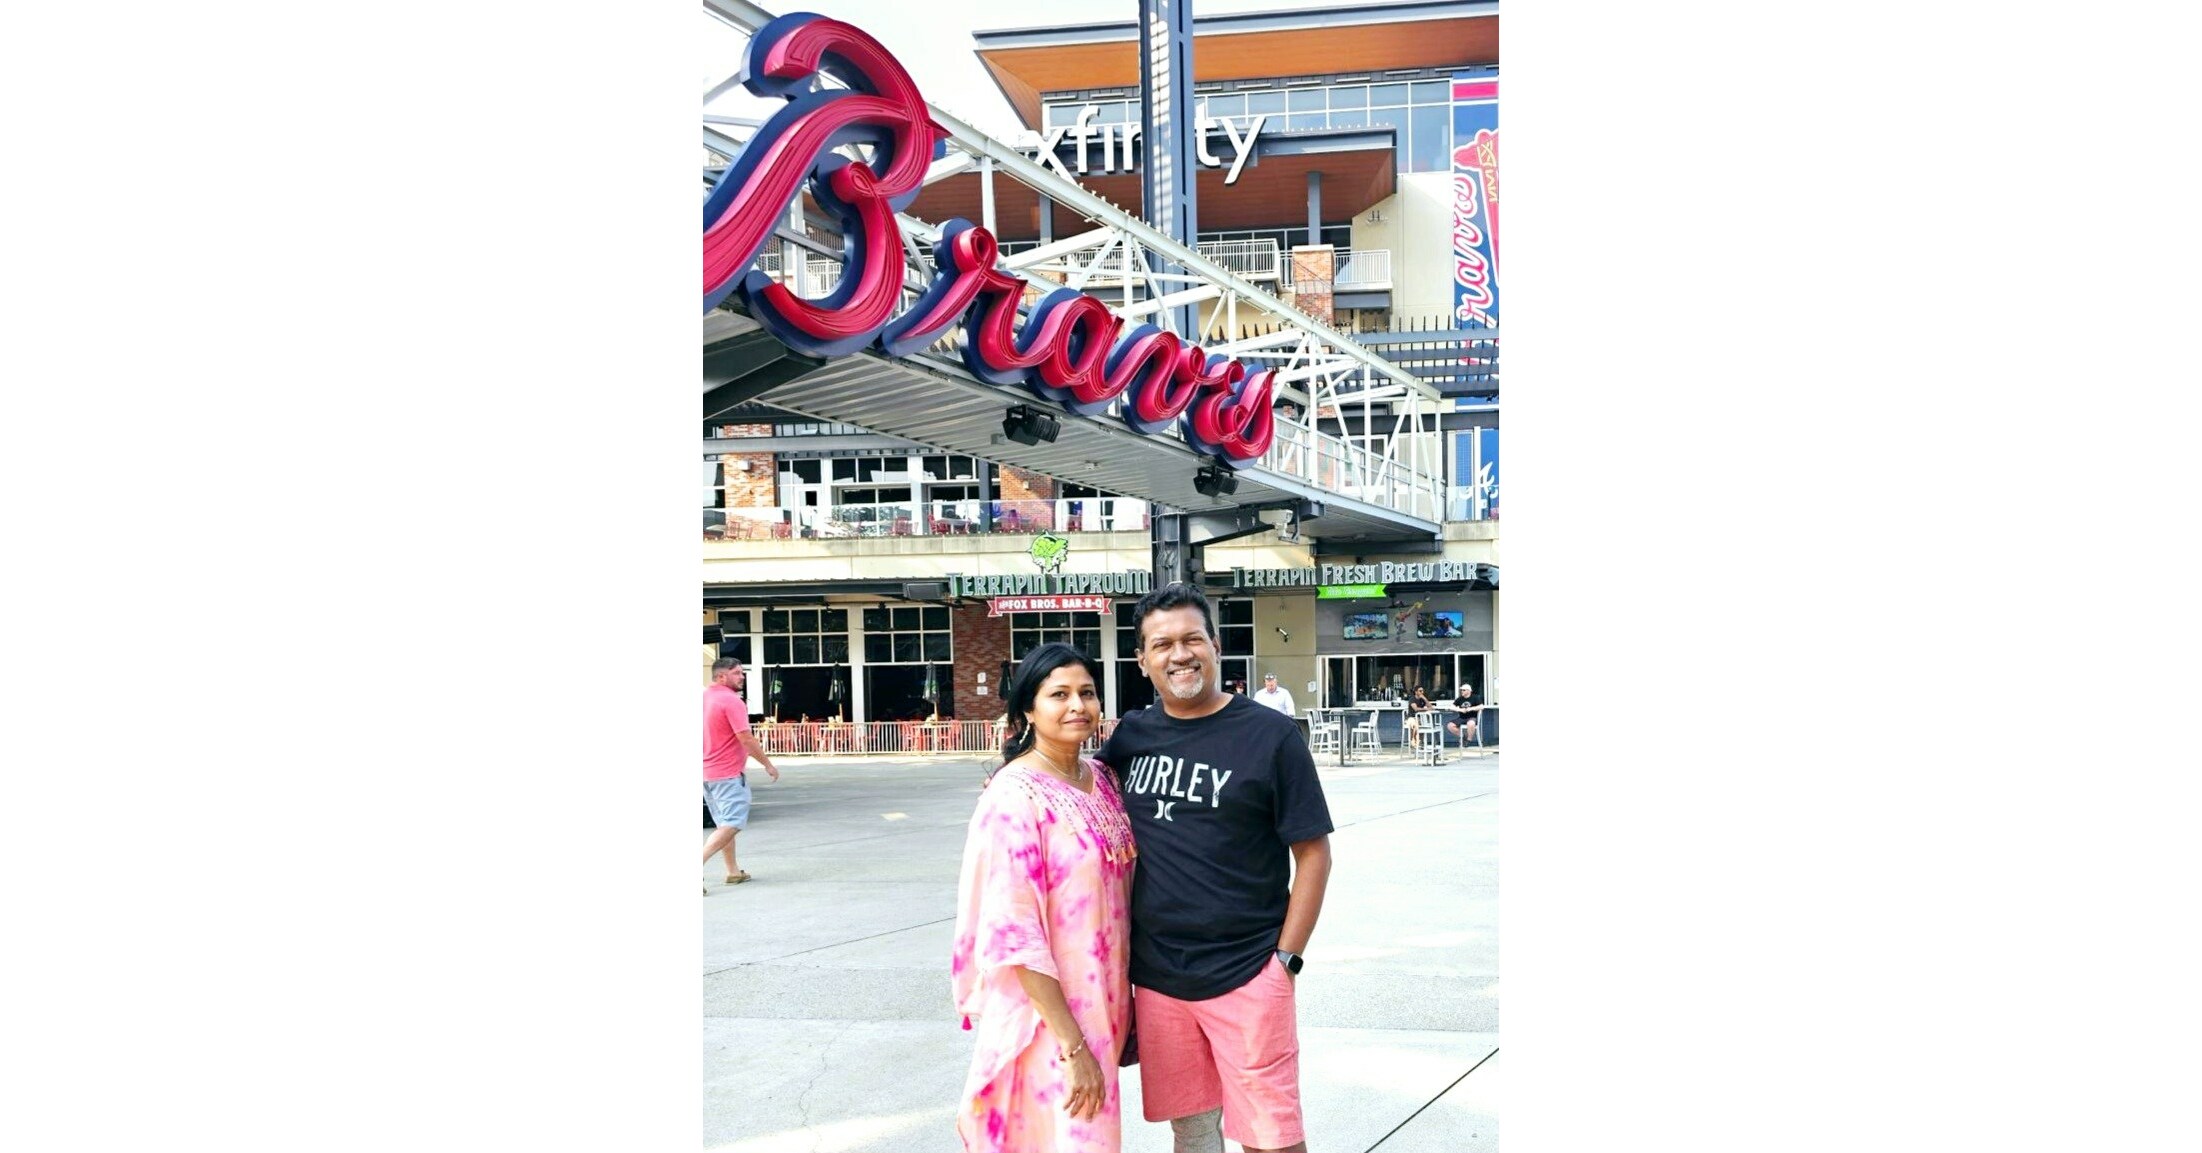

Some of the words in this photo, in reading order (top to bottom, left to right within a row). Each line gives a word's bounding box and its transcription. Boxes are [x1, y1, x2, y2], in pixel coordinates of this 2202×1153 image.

[703, 12, 1277, 470] Braves
[946, 572, 1048, 597] TERRAPIN
[1052, 568, 1151, 594] TAPROOM
[1230, 566, 1317, 588] TERRAPIN
[1321, 563, 1378, 586] FRESH
[1380, 561, 1435, 584] BREW
[1438, 559, 1478, 582] BAR
[1008, 599, 1028, 610] FOX
[1030, 598, 1060, 609] BROS.
[1124, 754, 1233, 808] HURLEY
